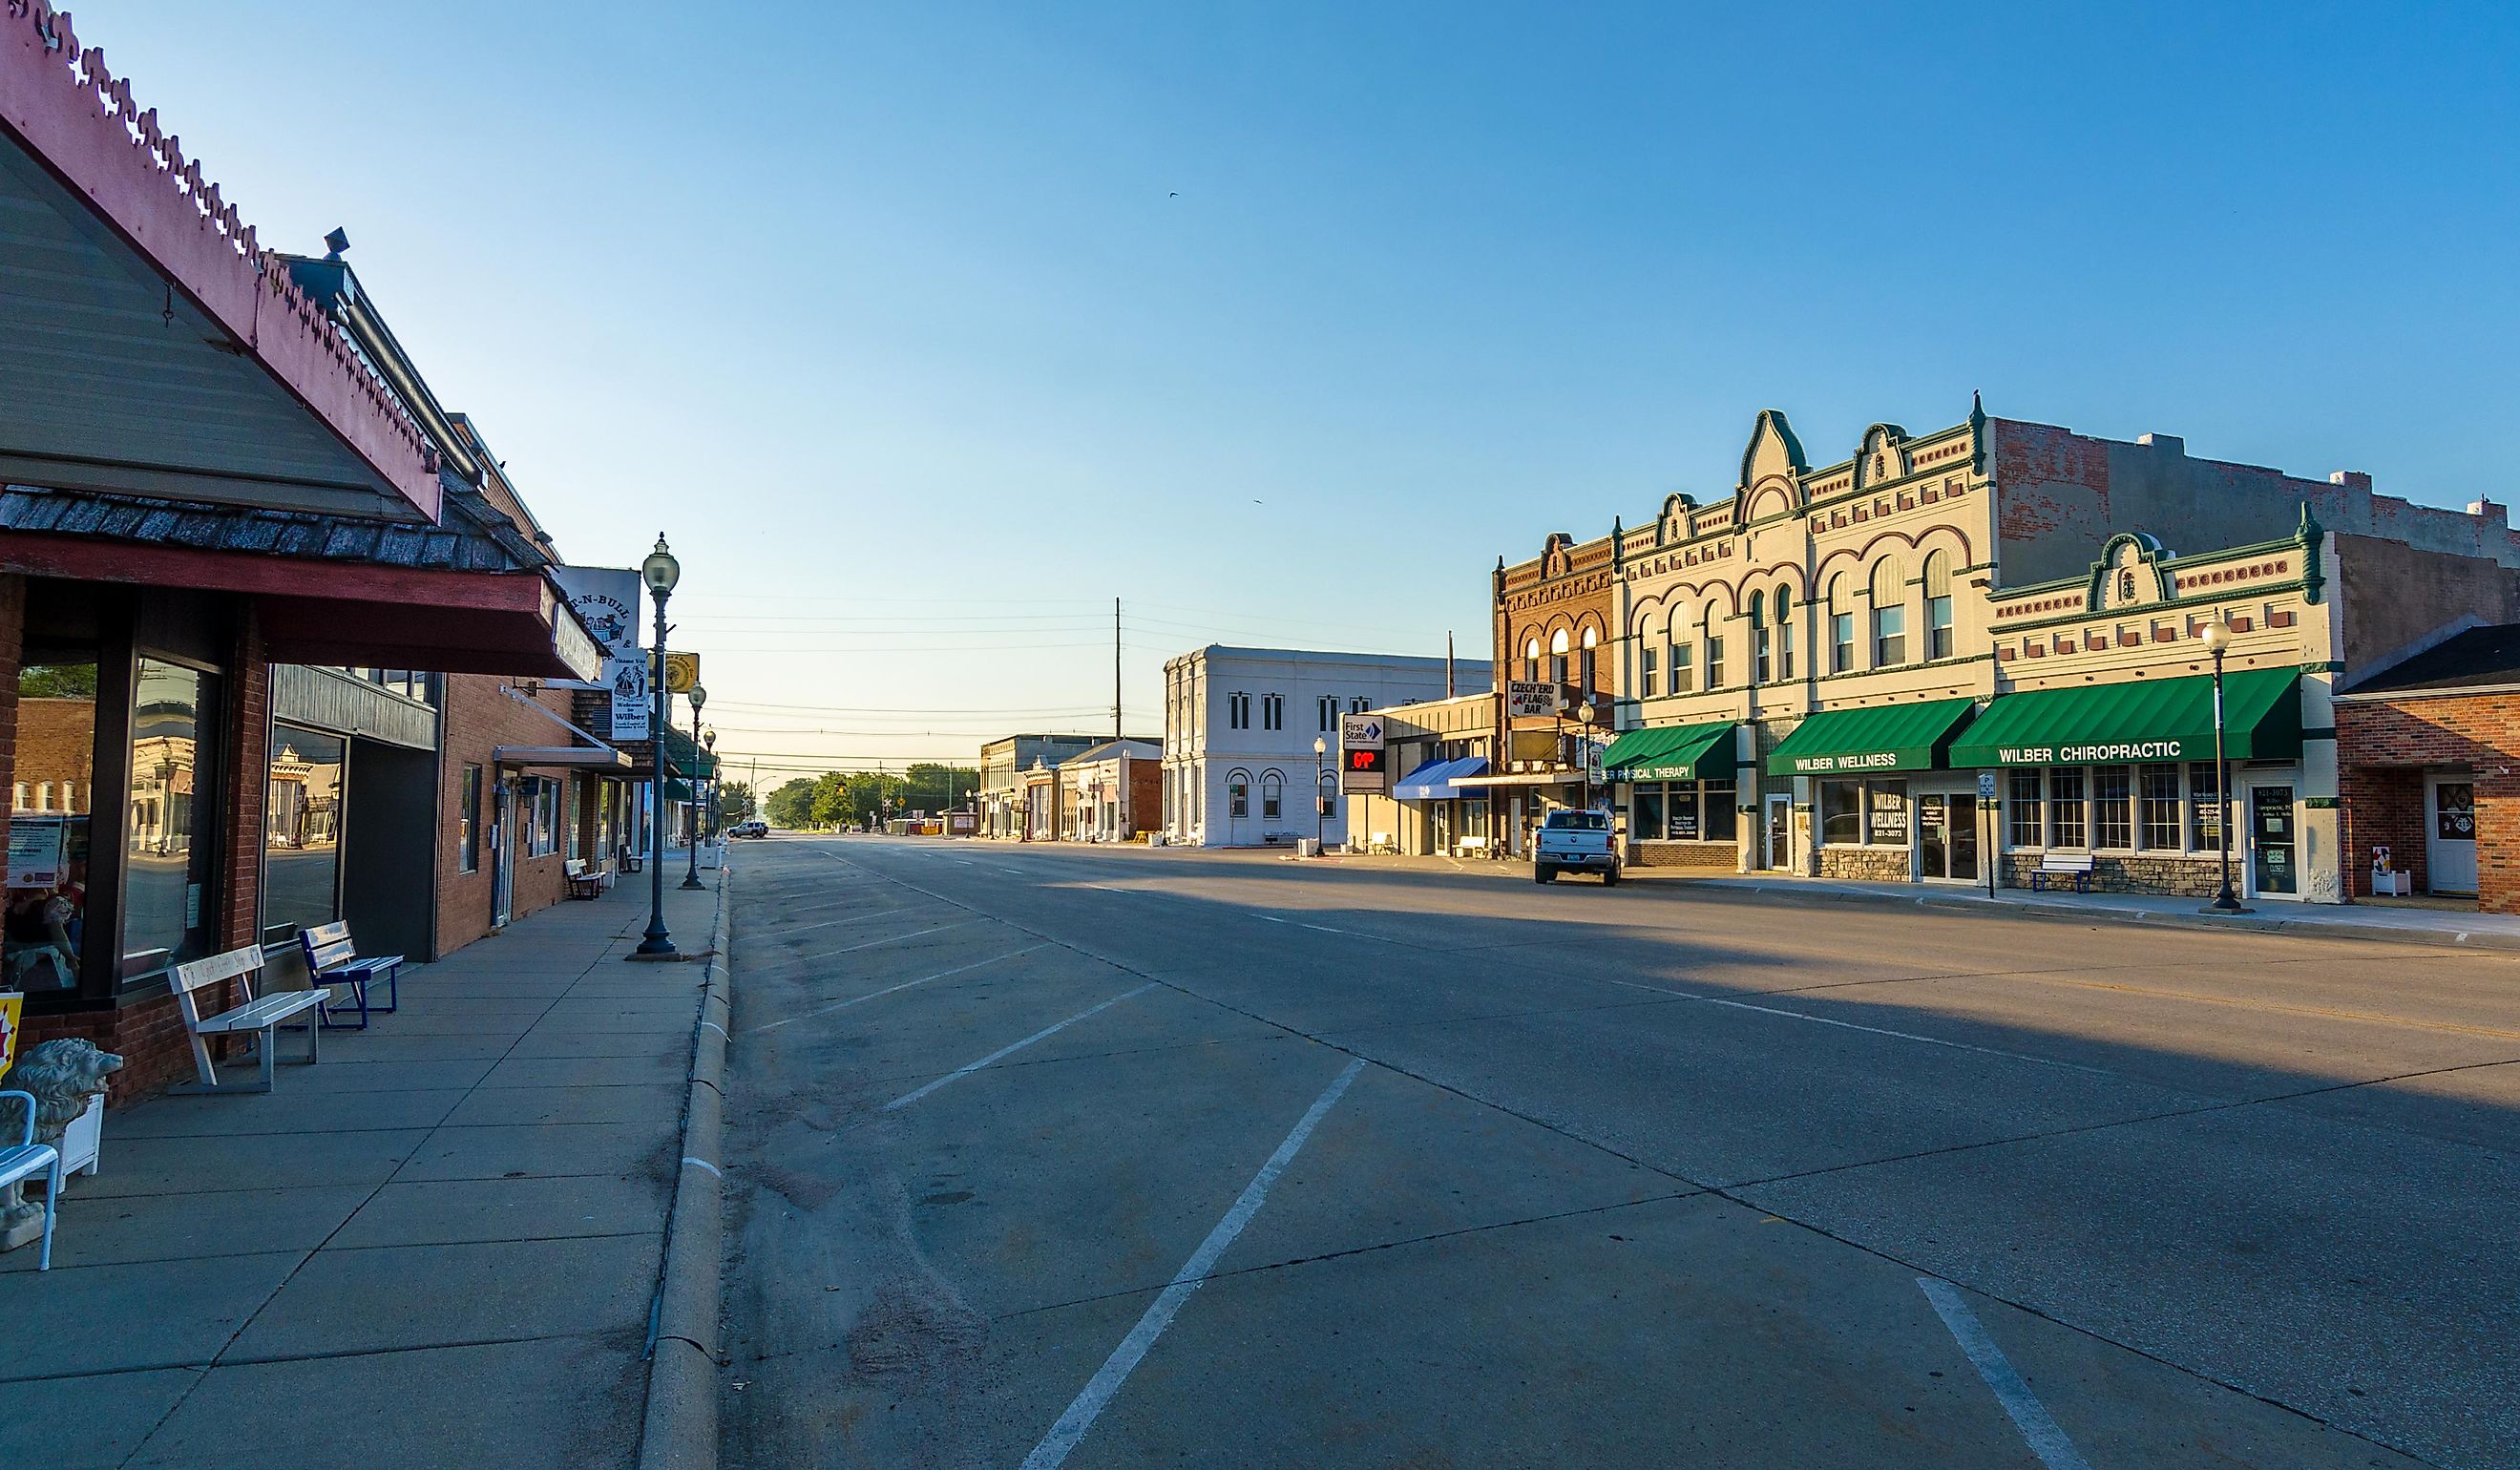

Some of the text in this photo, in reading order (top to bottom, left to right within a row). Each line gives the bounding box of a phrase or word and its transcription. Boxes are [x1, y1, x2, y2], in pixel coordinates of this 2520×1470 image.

[572, 595, 630, 620] T-N-BULL
[1511, 682, 1555, 694] CZECH'ERD
[1522, 694, 1544, 704] FLAG
[1523, 704, 1542, 714] BAR
[1345, 722, 1364, 731] First
[1345, 730, 1367, 740] State
[1999, 741, 2181, 763] WILBER CHIROPRACTIC
[1795, 752, 1897, 771] WILBER WELLNESS
[1617, 767, 1652, 779] PHYSICAL
[1654, 766, 1690, 778] THERAPY
[1873, 793, 1901, 809] WILBER
[1871, 811, 1906, 829] WELLNESS
